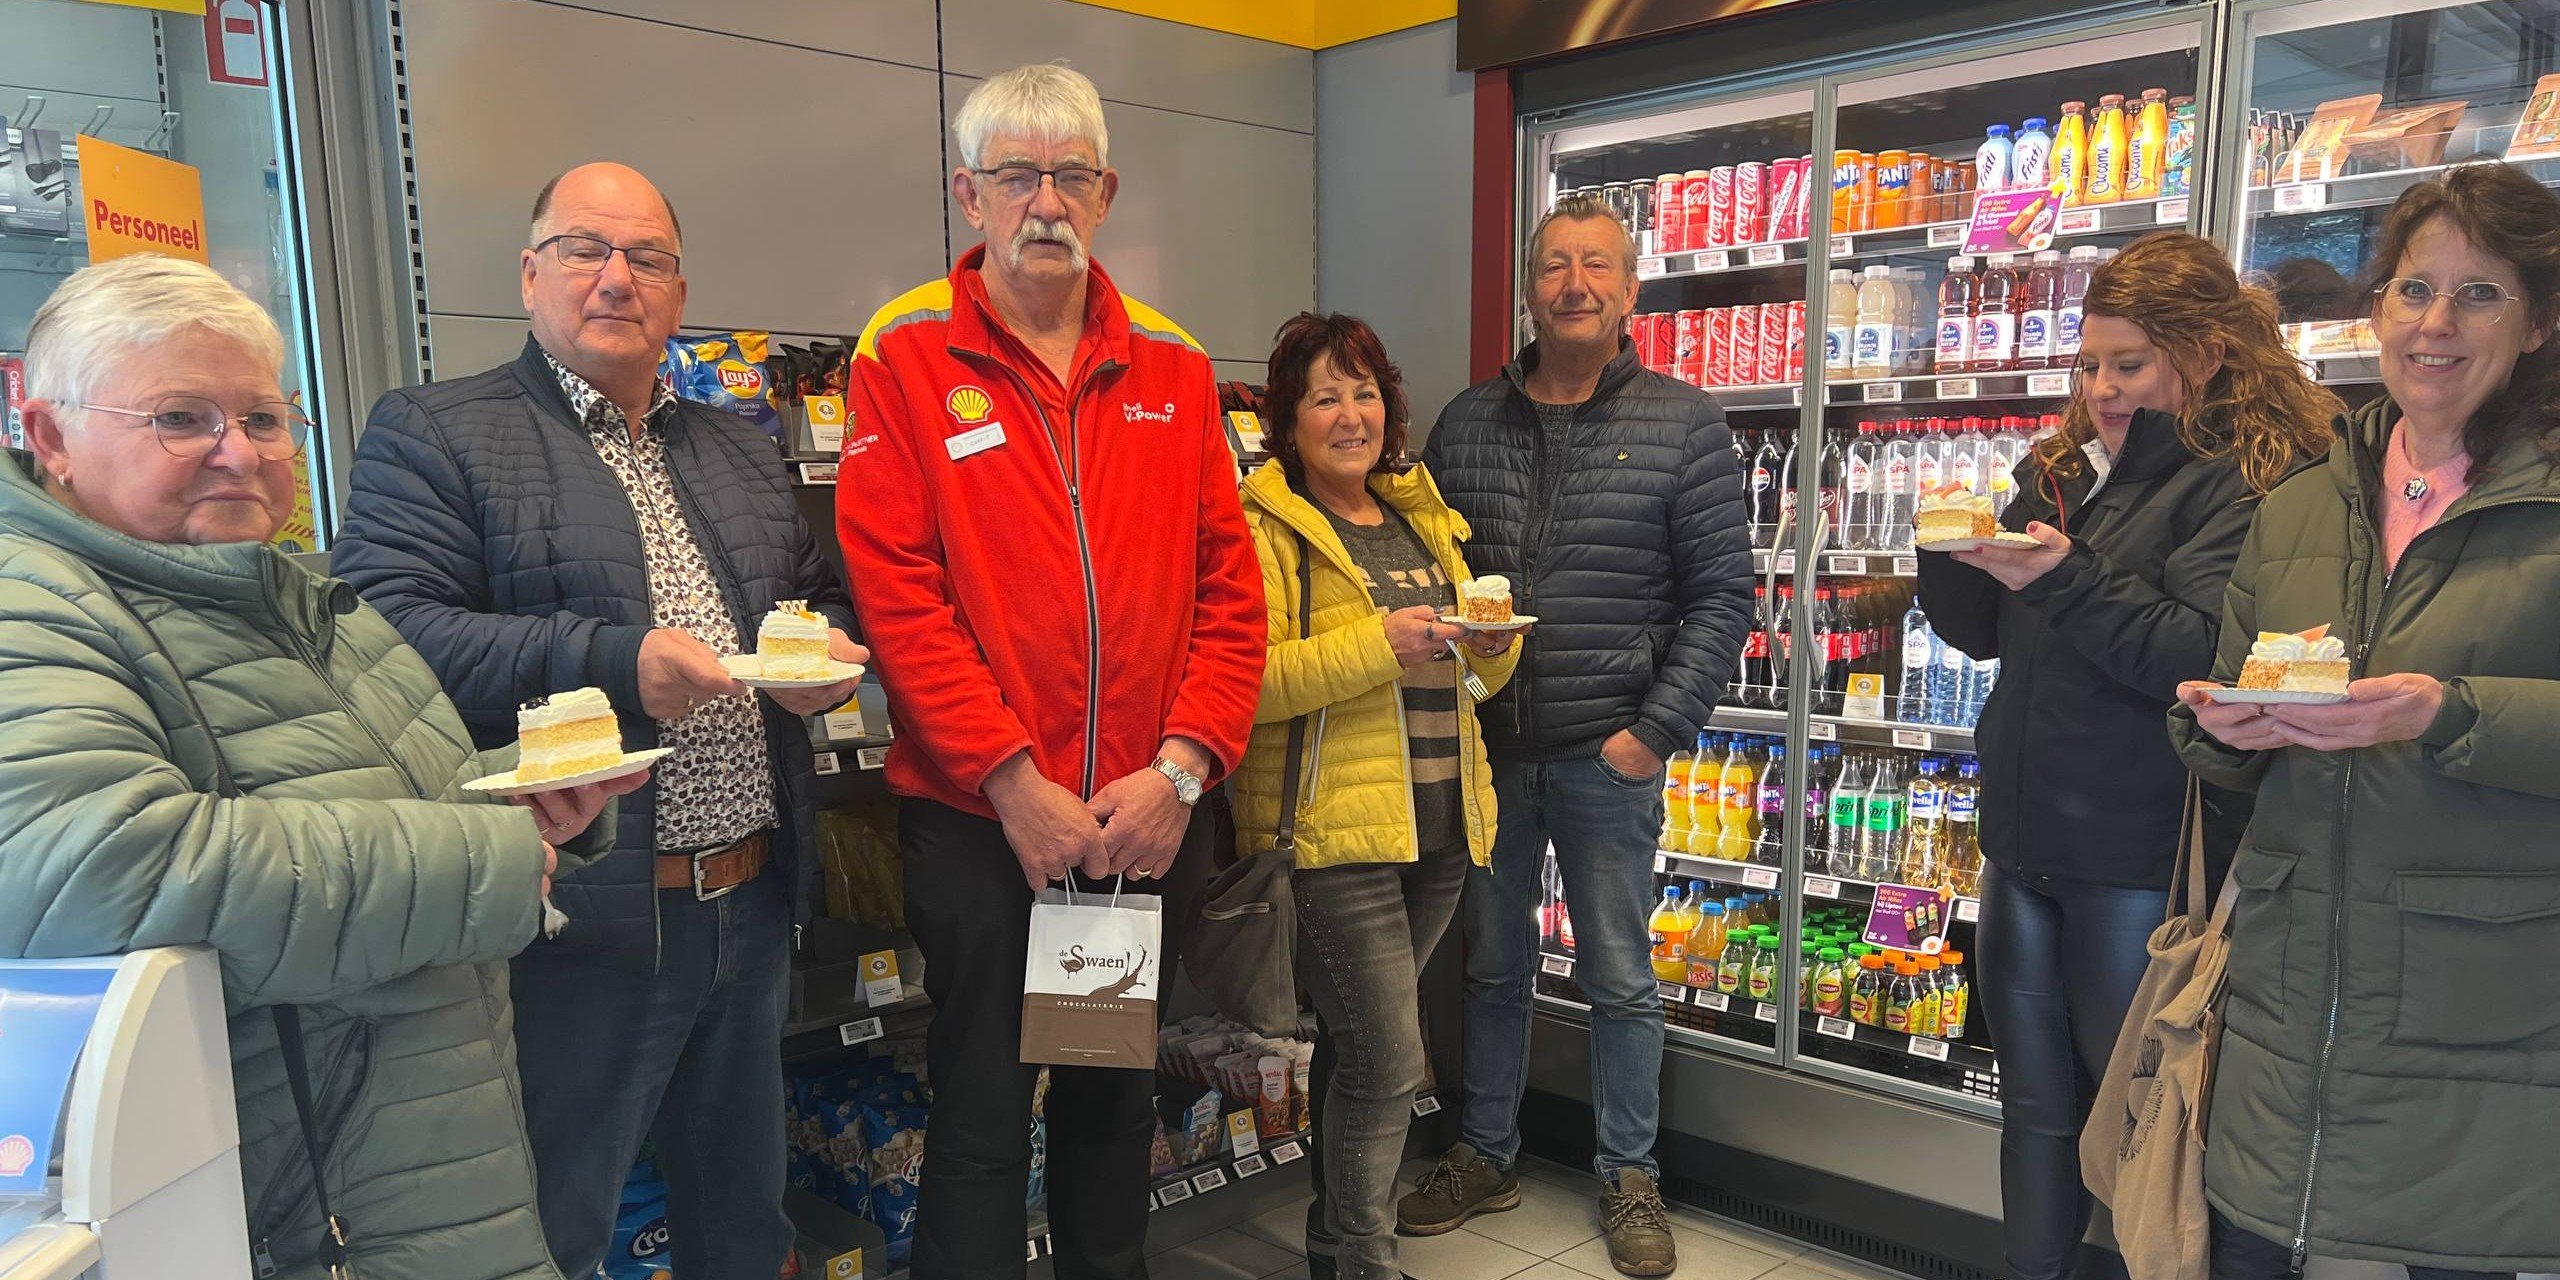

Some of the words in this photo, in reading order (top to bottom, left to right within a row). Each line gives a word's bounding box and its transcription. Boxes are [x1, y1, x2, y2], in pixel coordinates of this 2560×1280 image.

[2021, 142, 2044, 181] Fristi
[1877, 164, 1910, 186] FANT
[93, 199, 200, 251] Personeel
[1123, 411, 1173, 423] V-Power
[1889, 464, 1911, 474] SPA
[1060, 944, 1125, 974] Swaen
[1819, 984, 1839, 992] Lipton
[1057, 1001, 1124, 1010] CHOCOLATERIE
